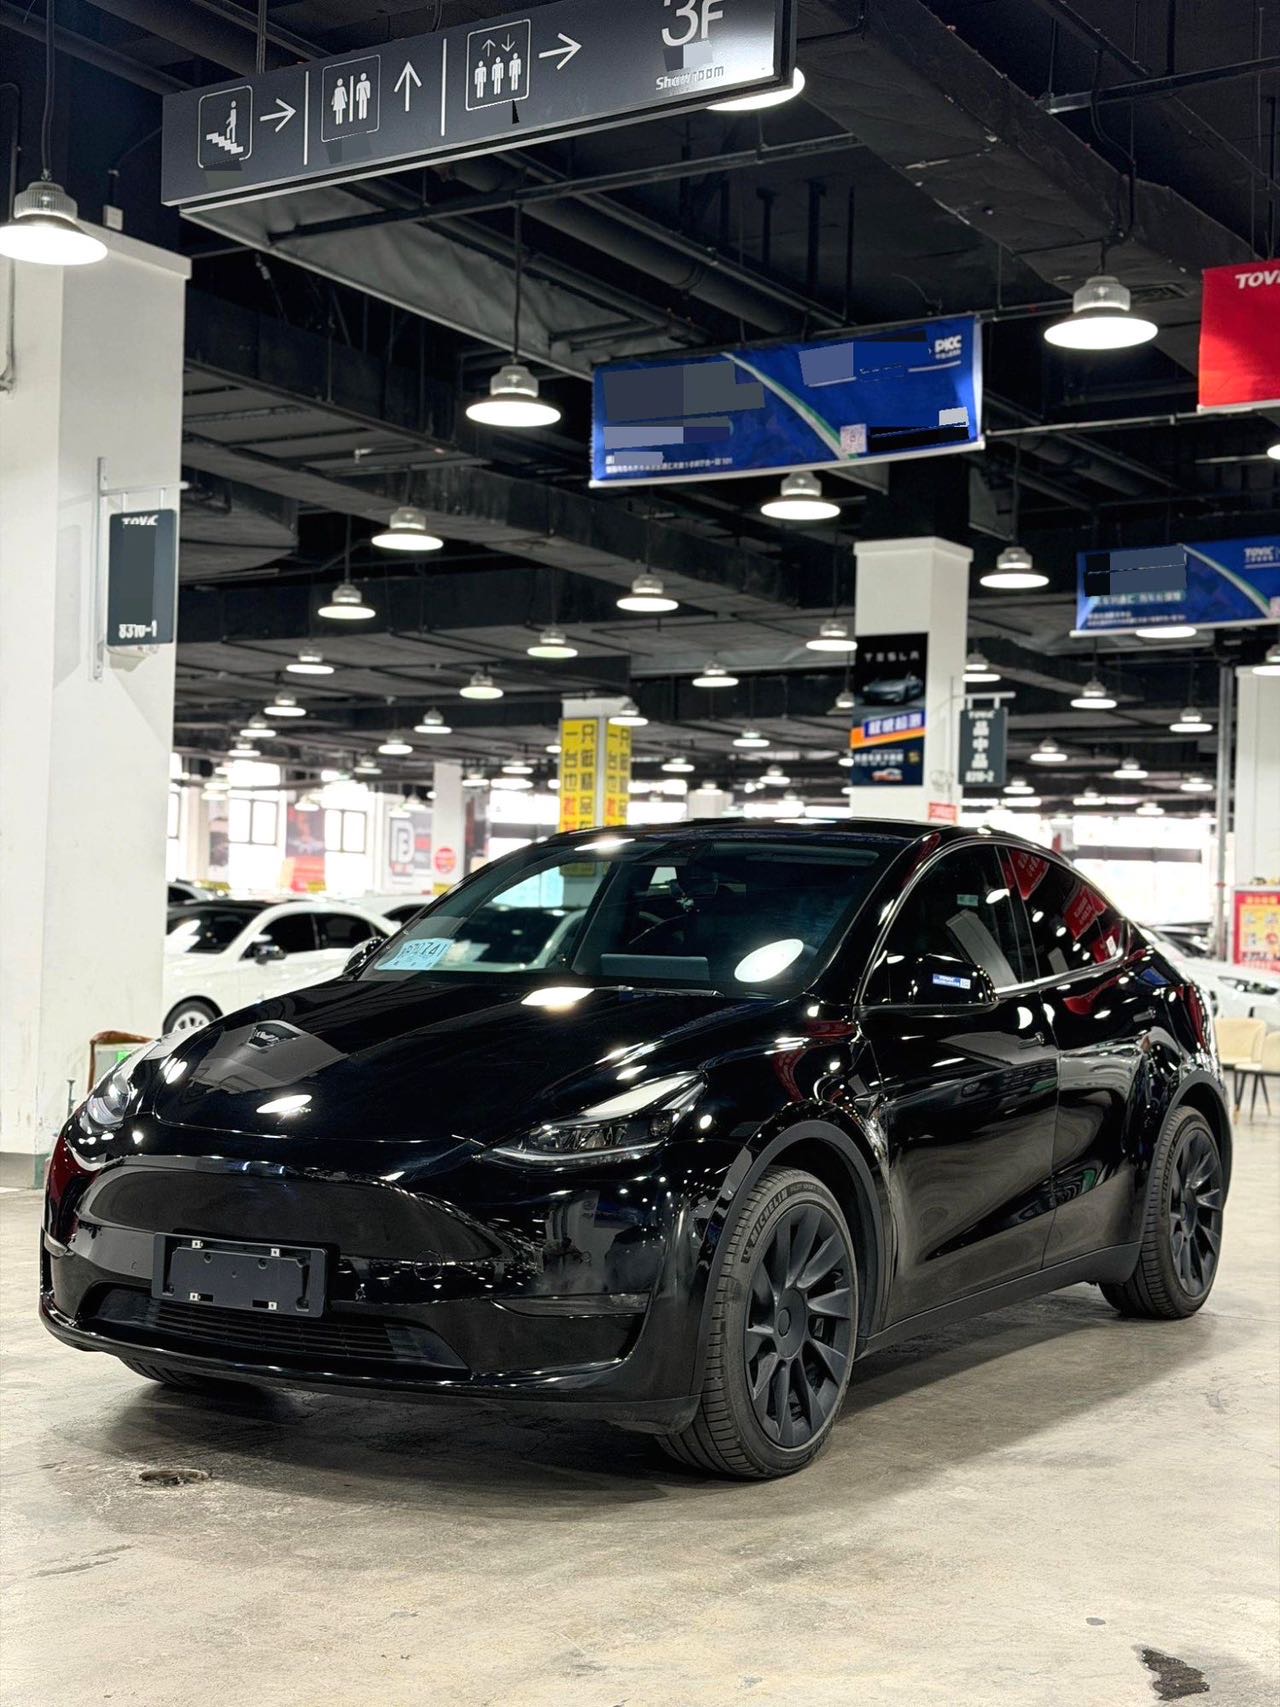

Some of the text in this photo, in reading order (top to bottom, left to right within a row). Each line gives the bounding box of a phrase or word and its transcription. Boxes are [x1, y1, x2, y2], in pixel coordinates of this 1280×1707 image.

[661, 0, 724, 47] 3F
[656, 66, 725, 91] Showroom
[750, 1188, 788, 1246] MICHELIN
